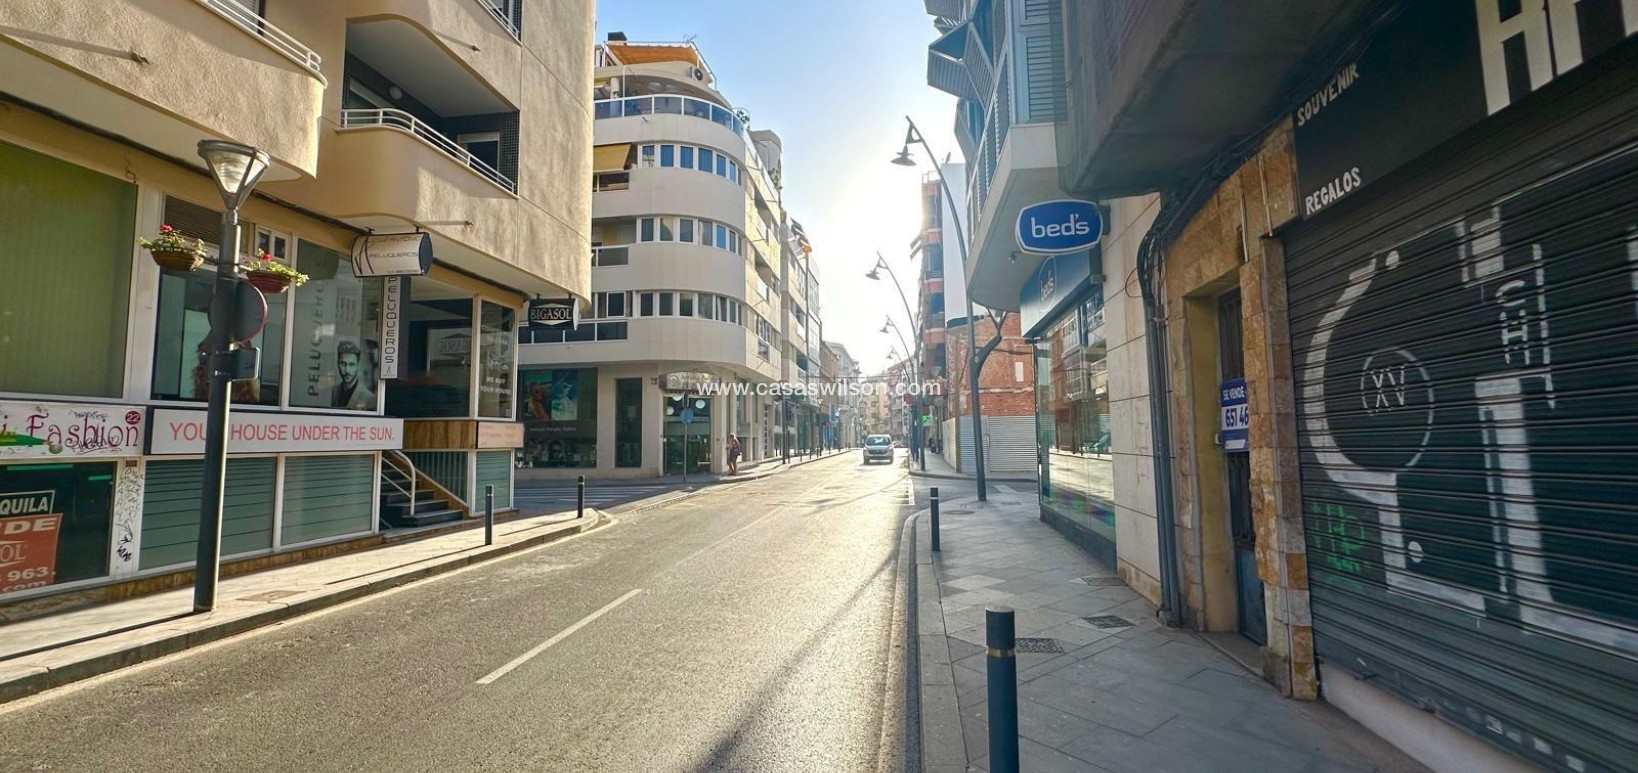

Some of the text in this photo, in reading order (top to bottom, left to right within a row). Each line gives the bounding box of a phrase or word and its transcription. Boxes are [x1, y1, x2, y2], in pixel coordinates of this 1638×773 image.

[1297, 63, 1360, 126] SOUVENIR
[1305, 167, 1362, 215] REGALOS
[1031, 213, 1090, 238] bed's
[385, 276, 398, 364] PELUQUEROS
[530, 307, 572, 320] BIGASOL
[127, 413, 139, 421] 22
[1226, 408, 1237, 427] 651
[26, 412, 139, 448] Fashion
[170, 422, 395, 441] YOU HOUSE UNDER THE SUN.
[0, 518, 56, 535] DE
